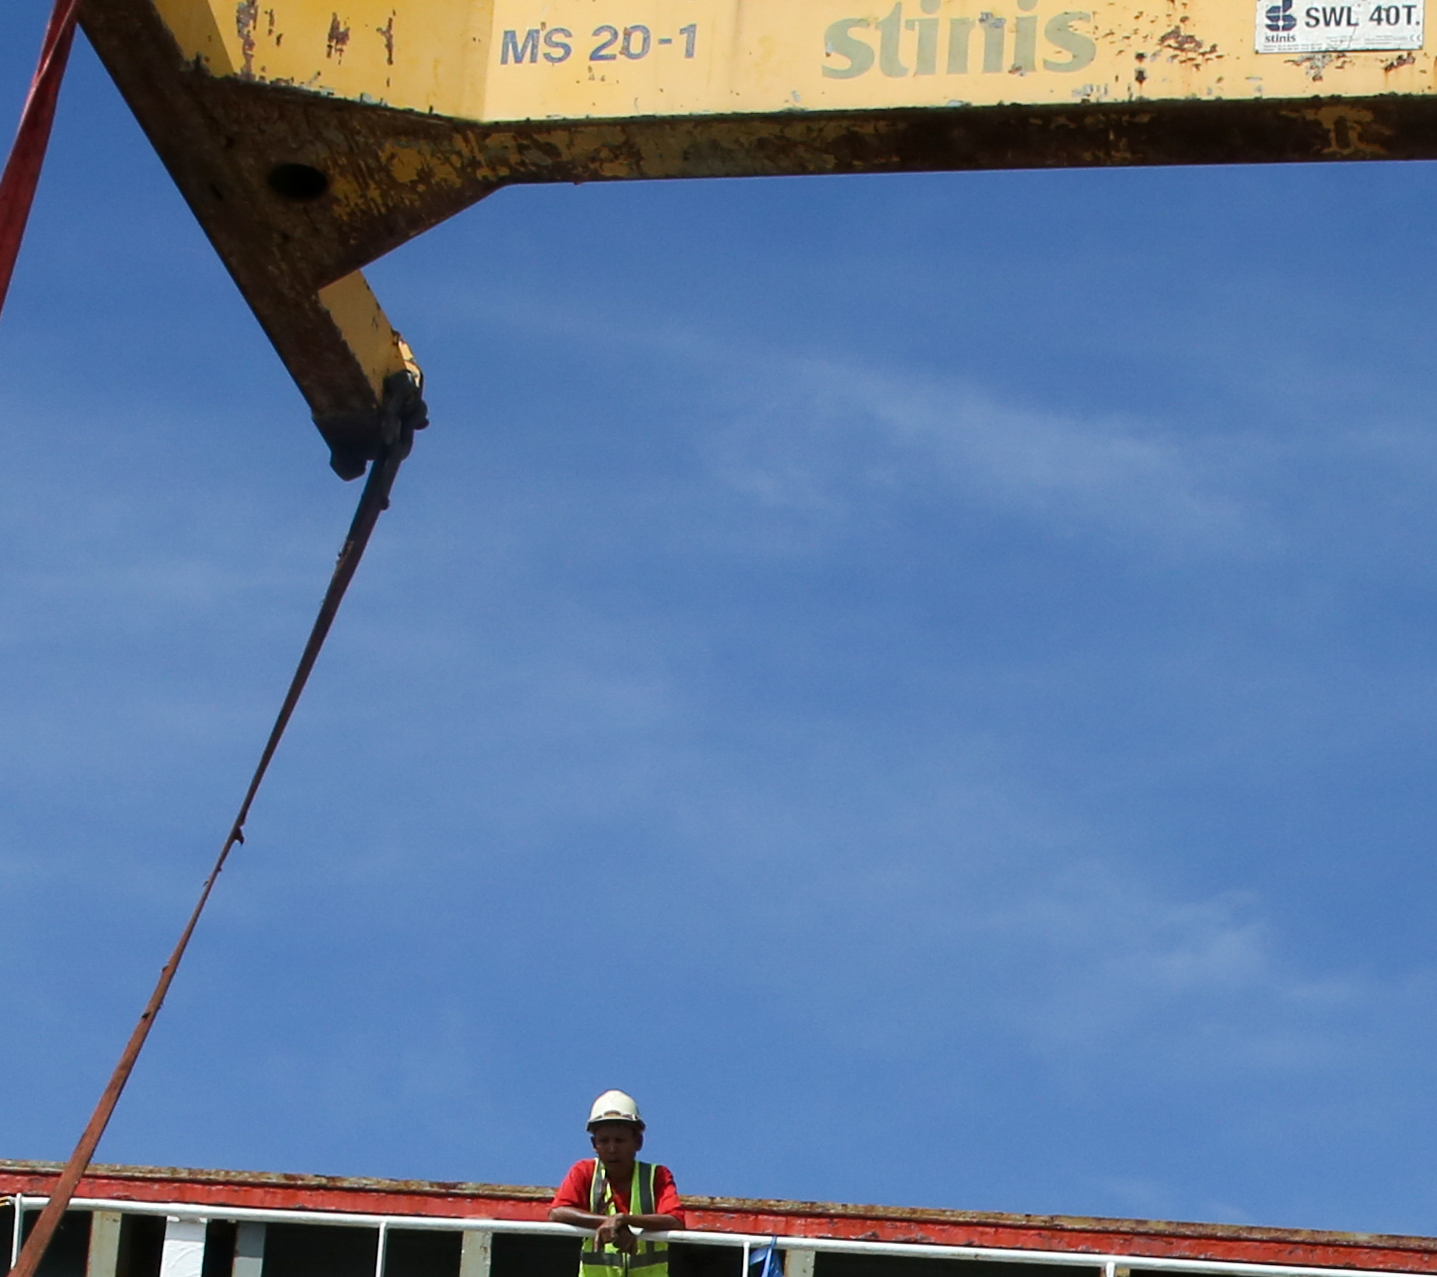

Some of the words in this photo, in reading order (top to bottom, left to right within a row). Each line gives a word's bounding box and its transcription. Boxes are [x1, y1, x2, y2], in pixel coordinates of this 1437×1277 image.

[1304, 5, 1359, 28] SWL
[500, 28, 573, 66] MS
[589, 24, 698, 62] 20-1
[821, 0, 1098, 80] stinis
[1264, 33, 1297, 43] stinis
